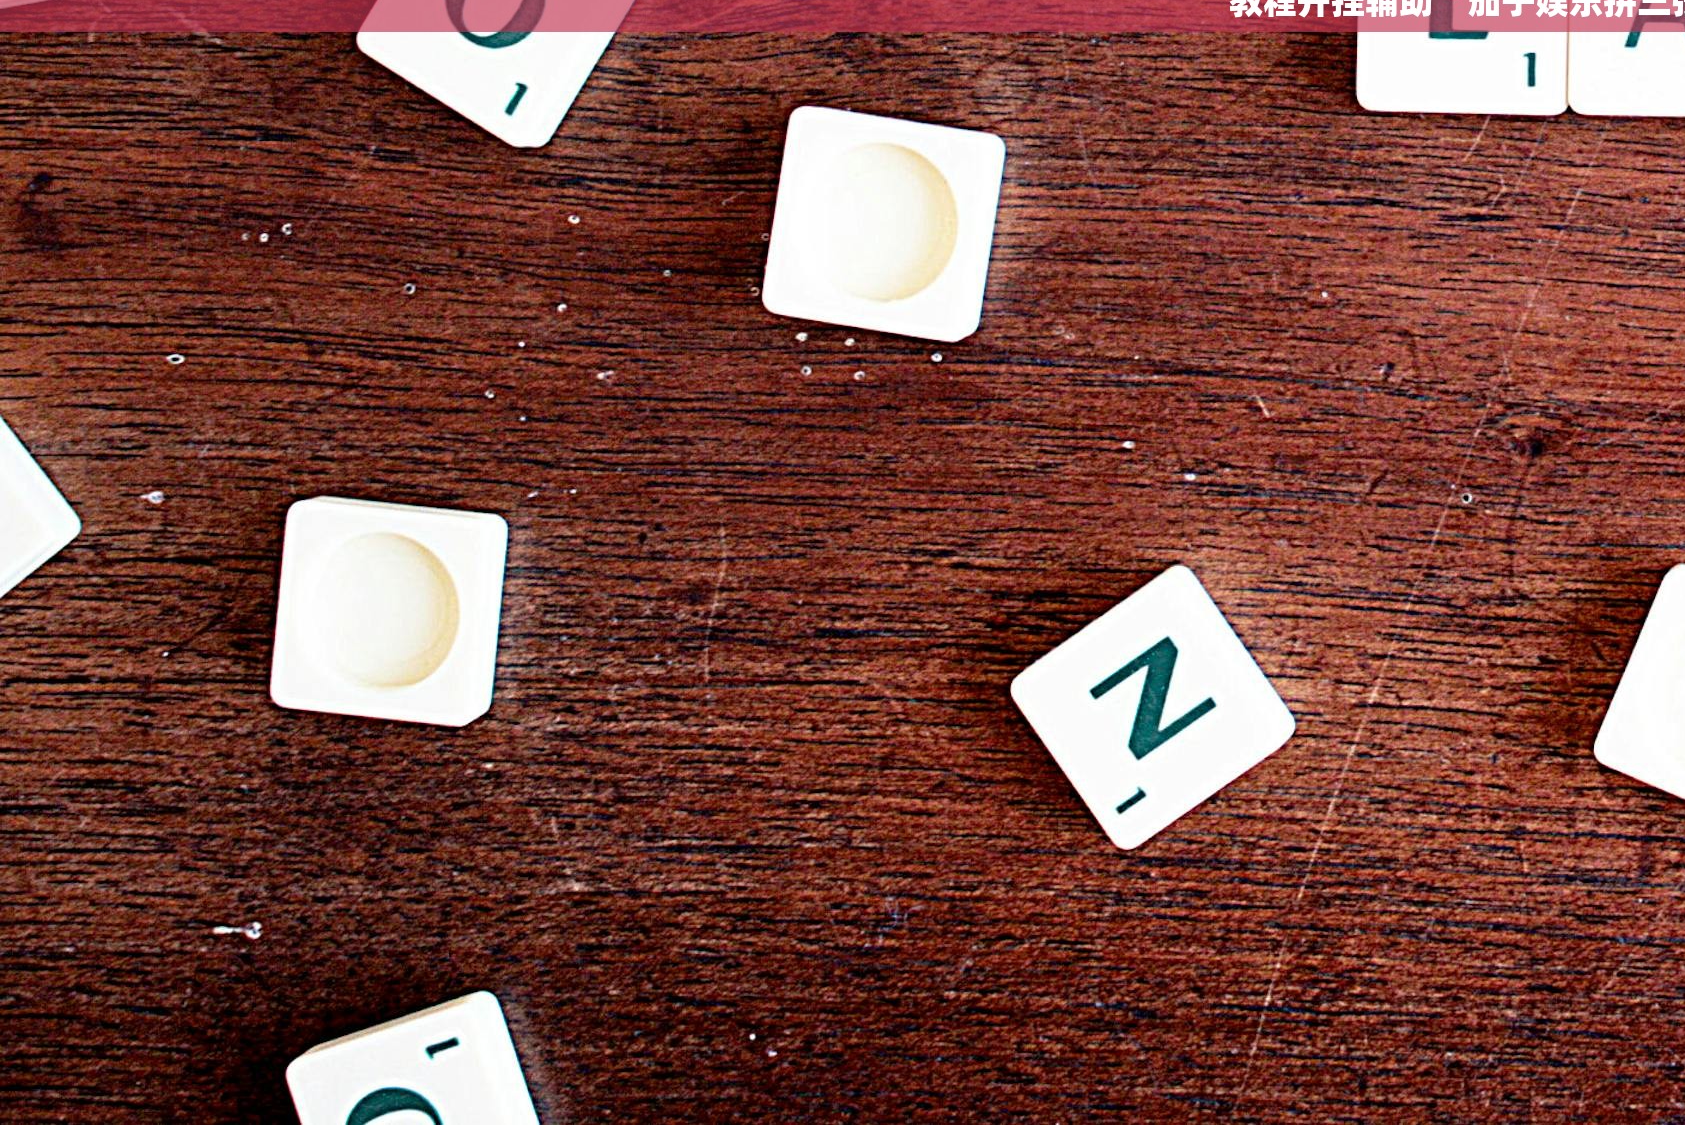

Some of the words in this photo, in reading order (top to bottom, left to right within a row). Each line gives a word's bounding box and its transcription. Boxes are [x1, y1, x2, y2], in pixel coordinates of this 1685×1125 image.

[1522, 51, 1537, 89] 1
[503, 81, 529, 117] 1
[1089, 636, 1217, 761] N
[1114, 786, 1148, 816] 1
[424, 1035, 461, 1061] 1
